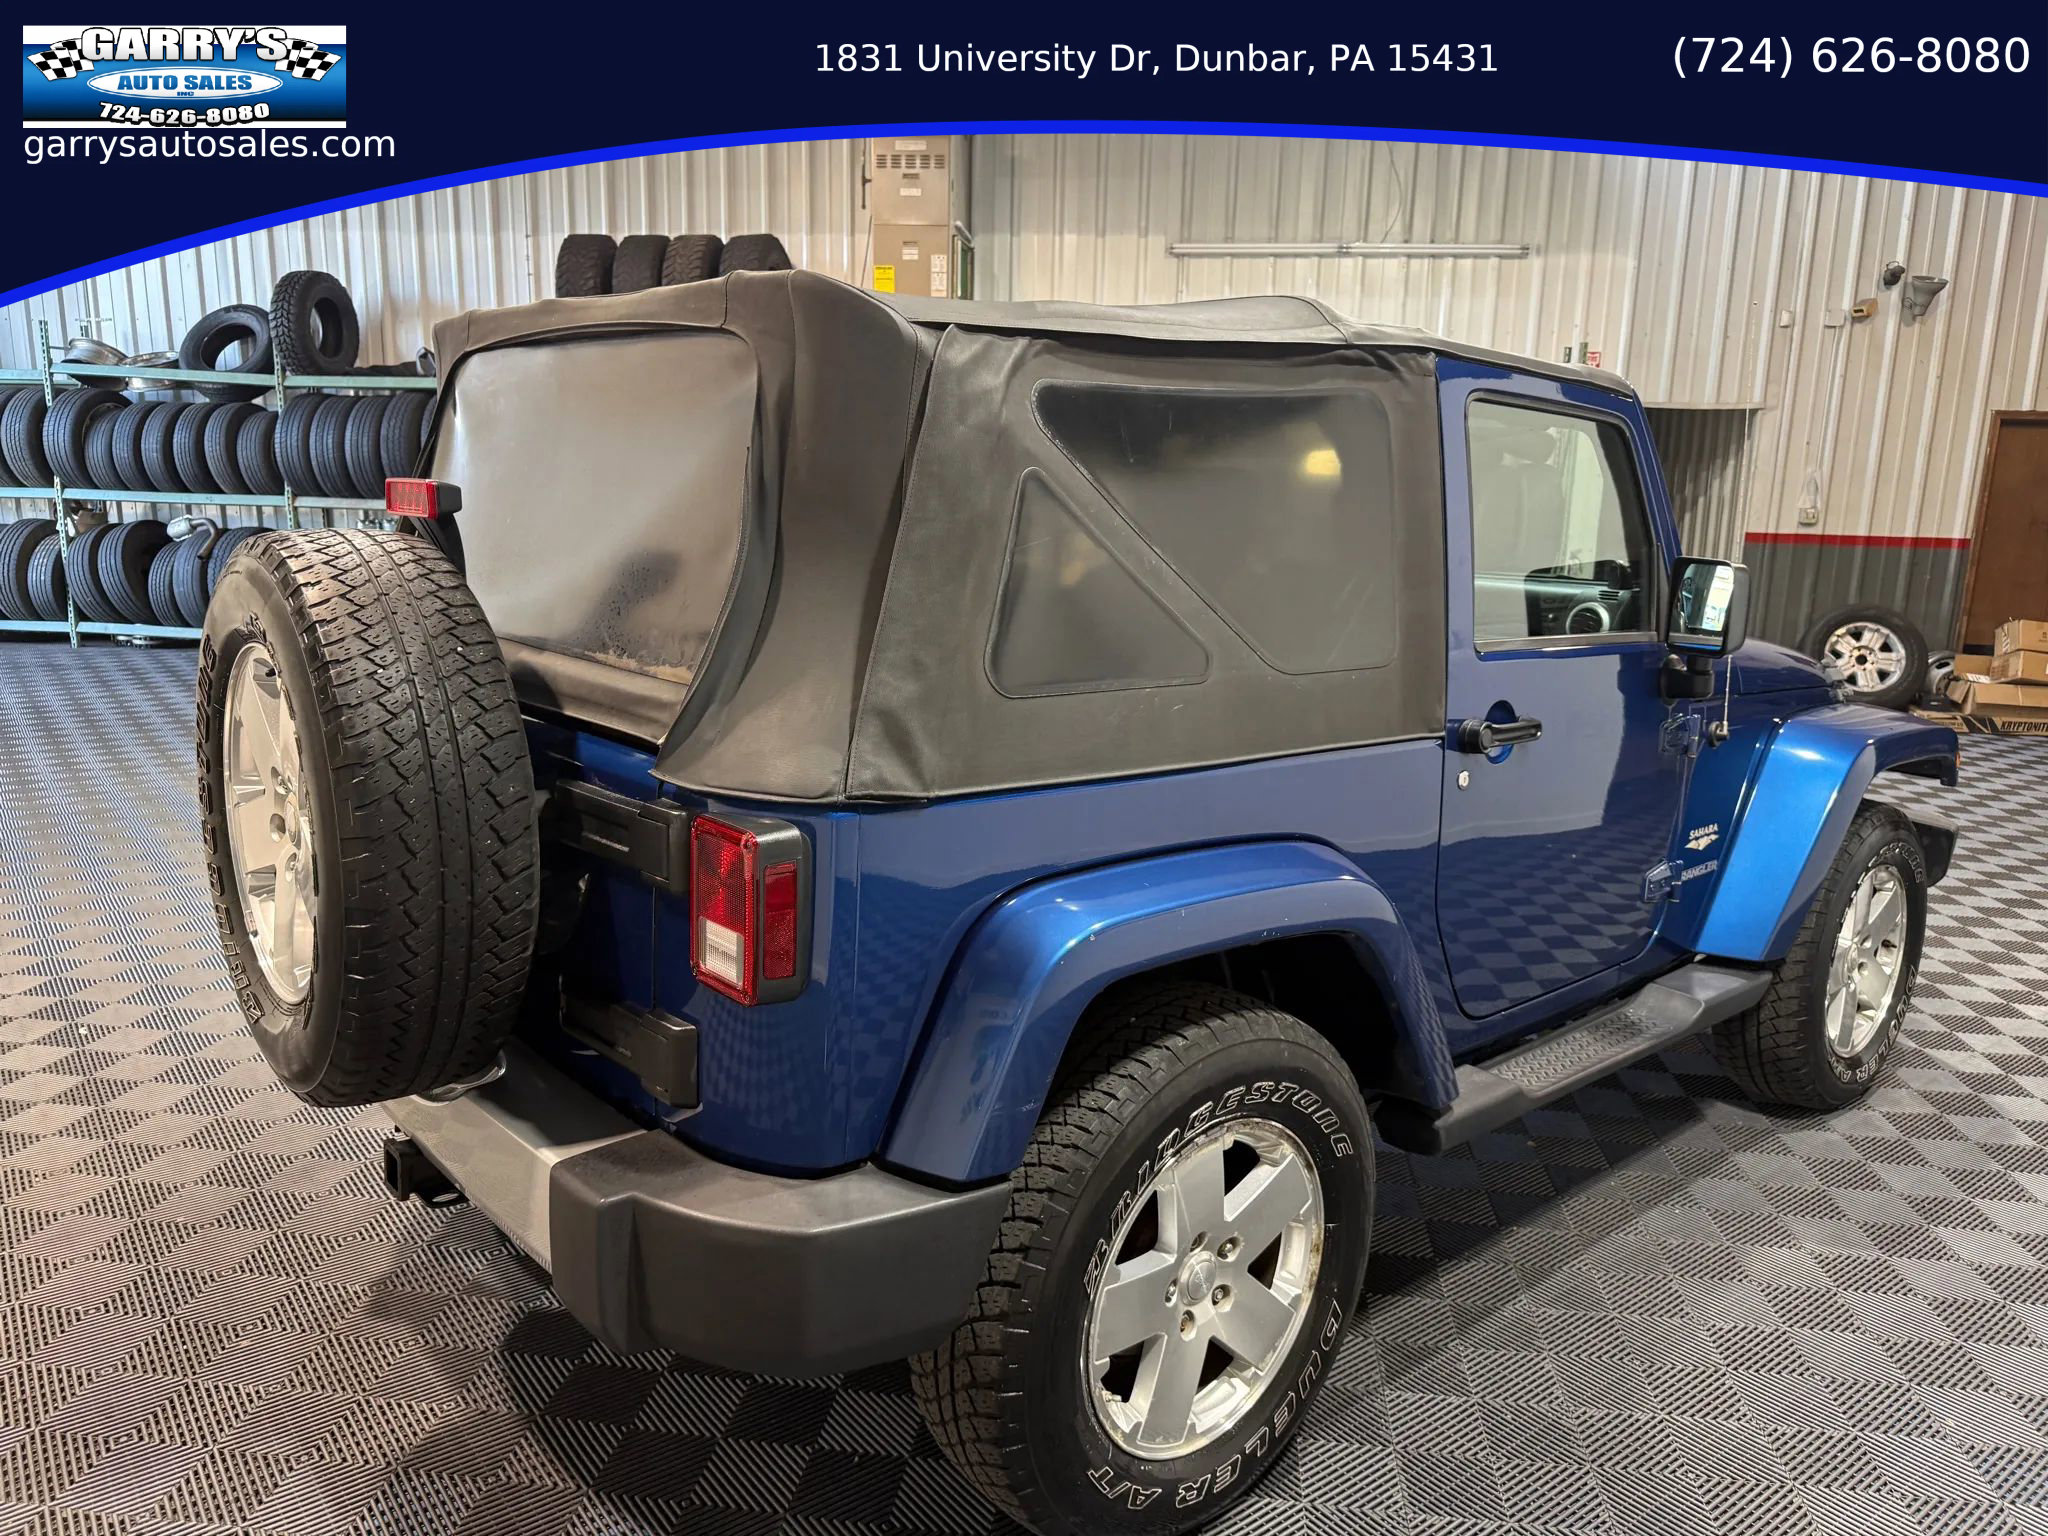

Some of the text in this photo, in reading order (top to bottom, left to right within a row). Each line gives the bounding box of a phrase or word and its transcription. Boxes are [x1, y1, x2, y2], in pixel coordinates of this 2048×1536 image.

[1681, 859, 1718, 881] RANGLER
[1688, 823, 1718, 840] SAHARA
[1083, 1081, 1354, 1297] BRIDGESTONE
[1088, 1298, 1343, 1509] DUELER A/T
